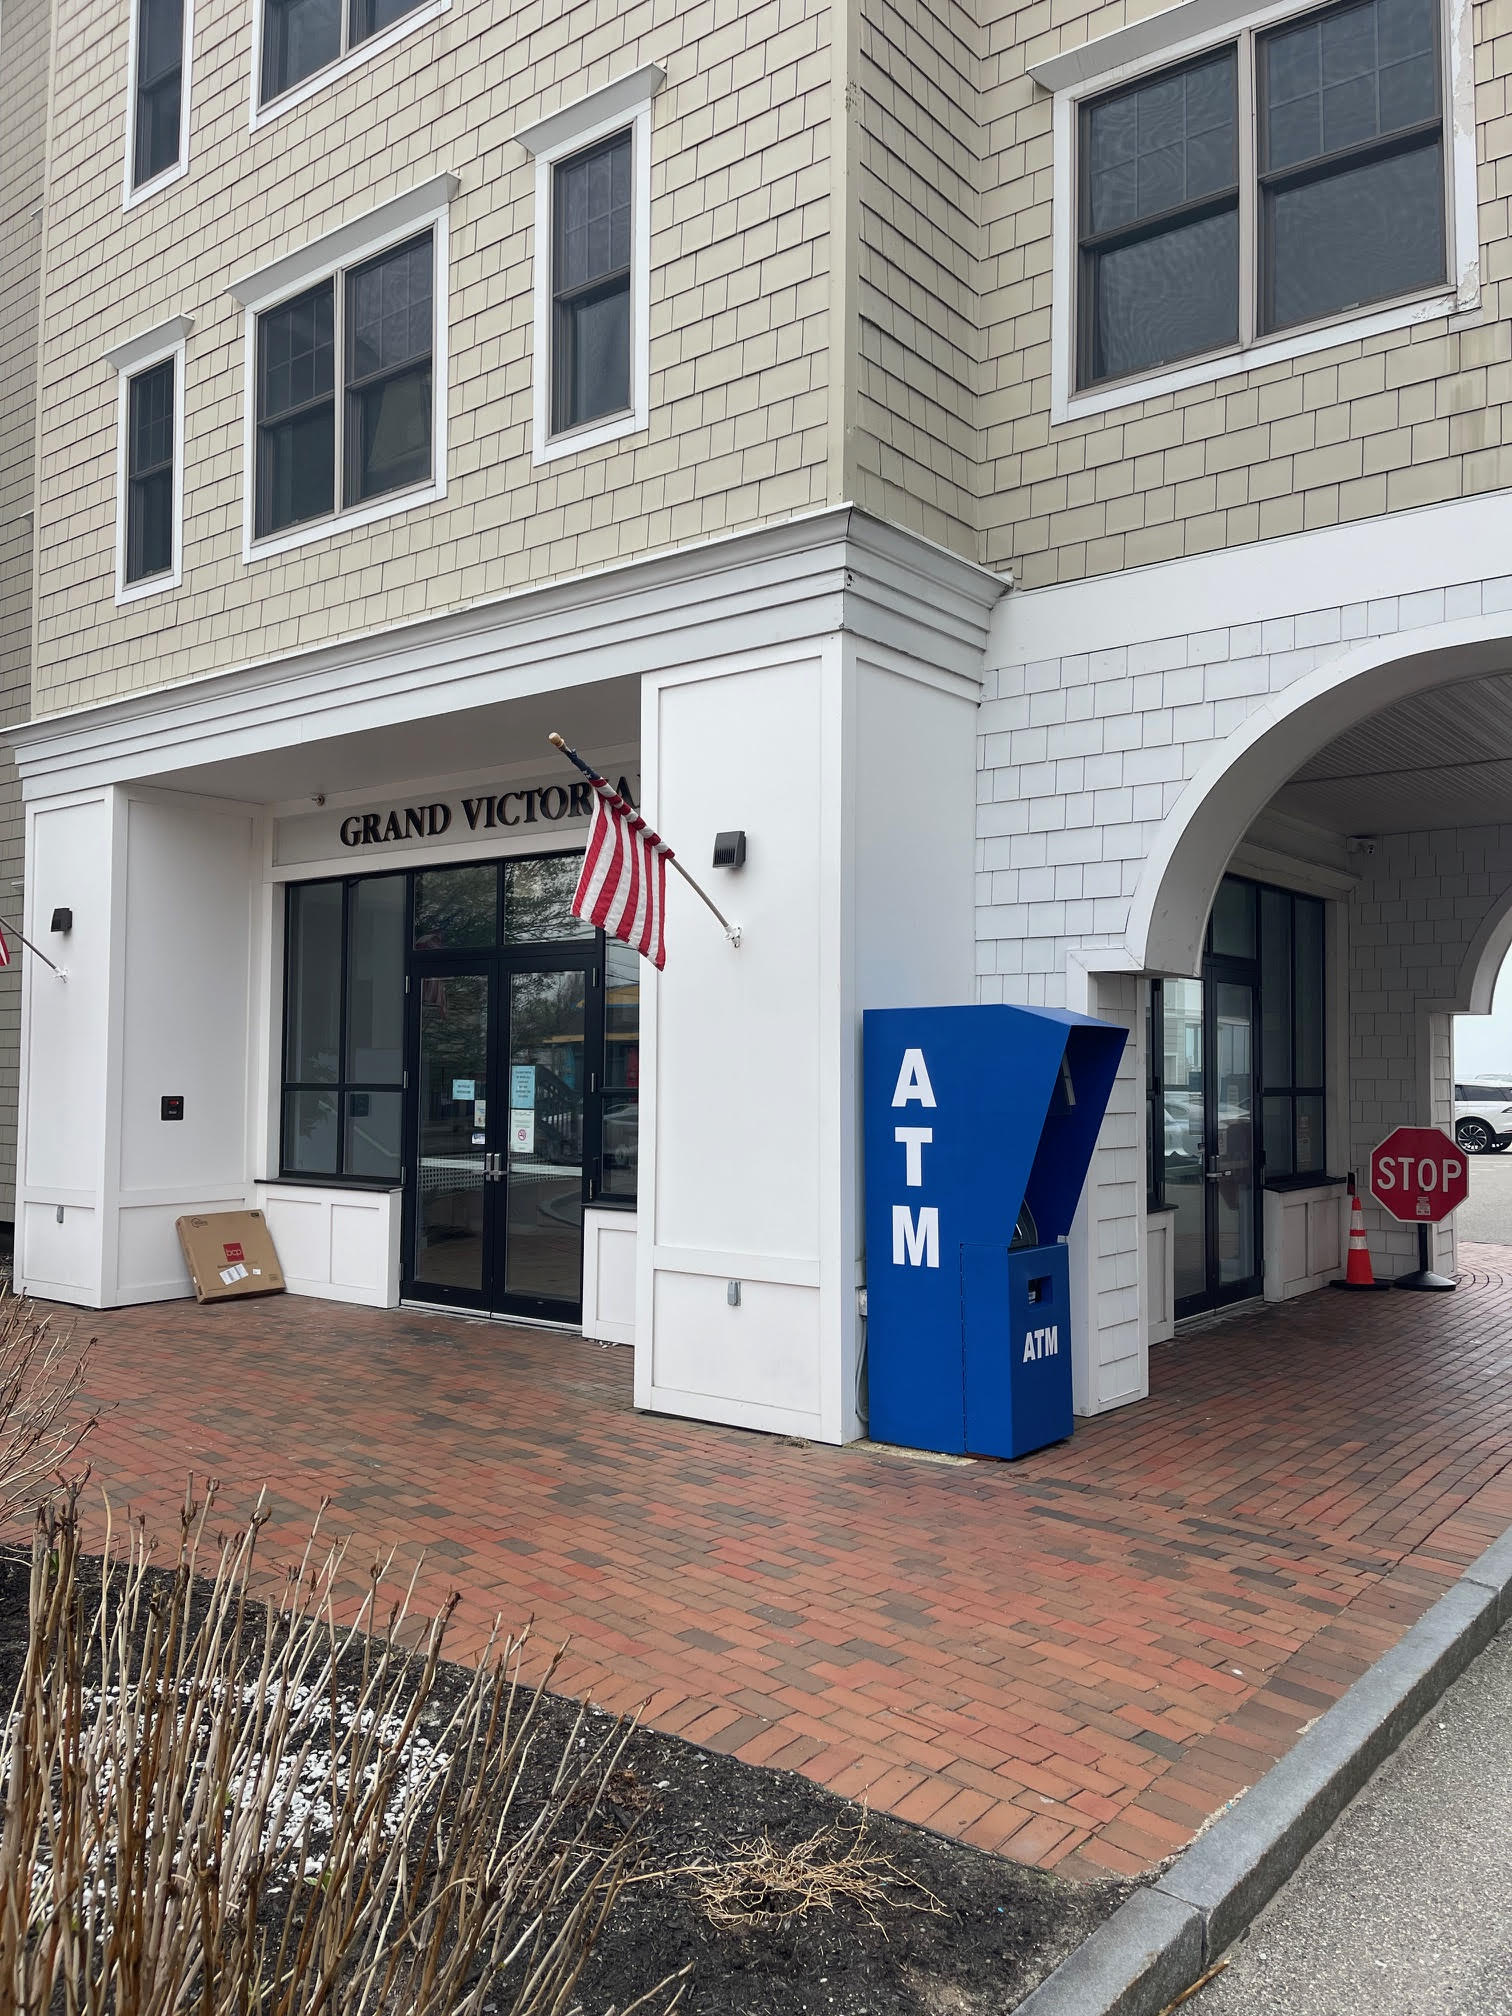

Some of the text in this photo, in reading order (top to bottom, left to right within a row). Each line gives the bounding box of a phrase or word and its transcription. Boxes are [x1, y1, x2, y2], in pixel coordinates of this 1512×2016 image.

[339, 774, 640, 847] GRAND VICTORA
[891, 1048, 940, 1268] ATM
[1377, 1156, 1462, 1193] STOP
[1022, 1325, 1058, 1363] ATM
